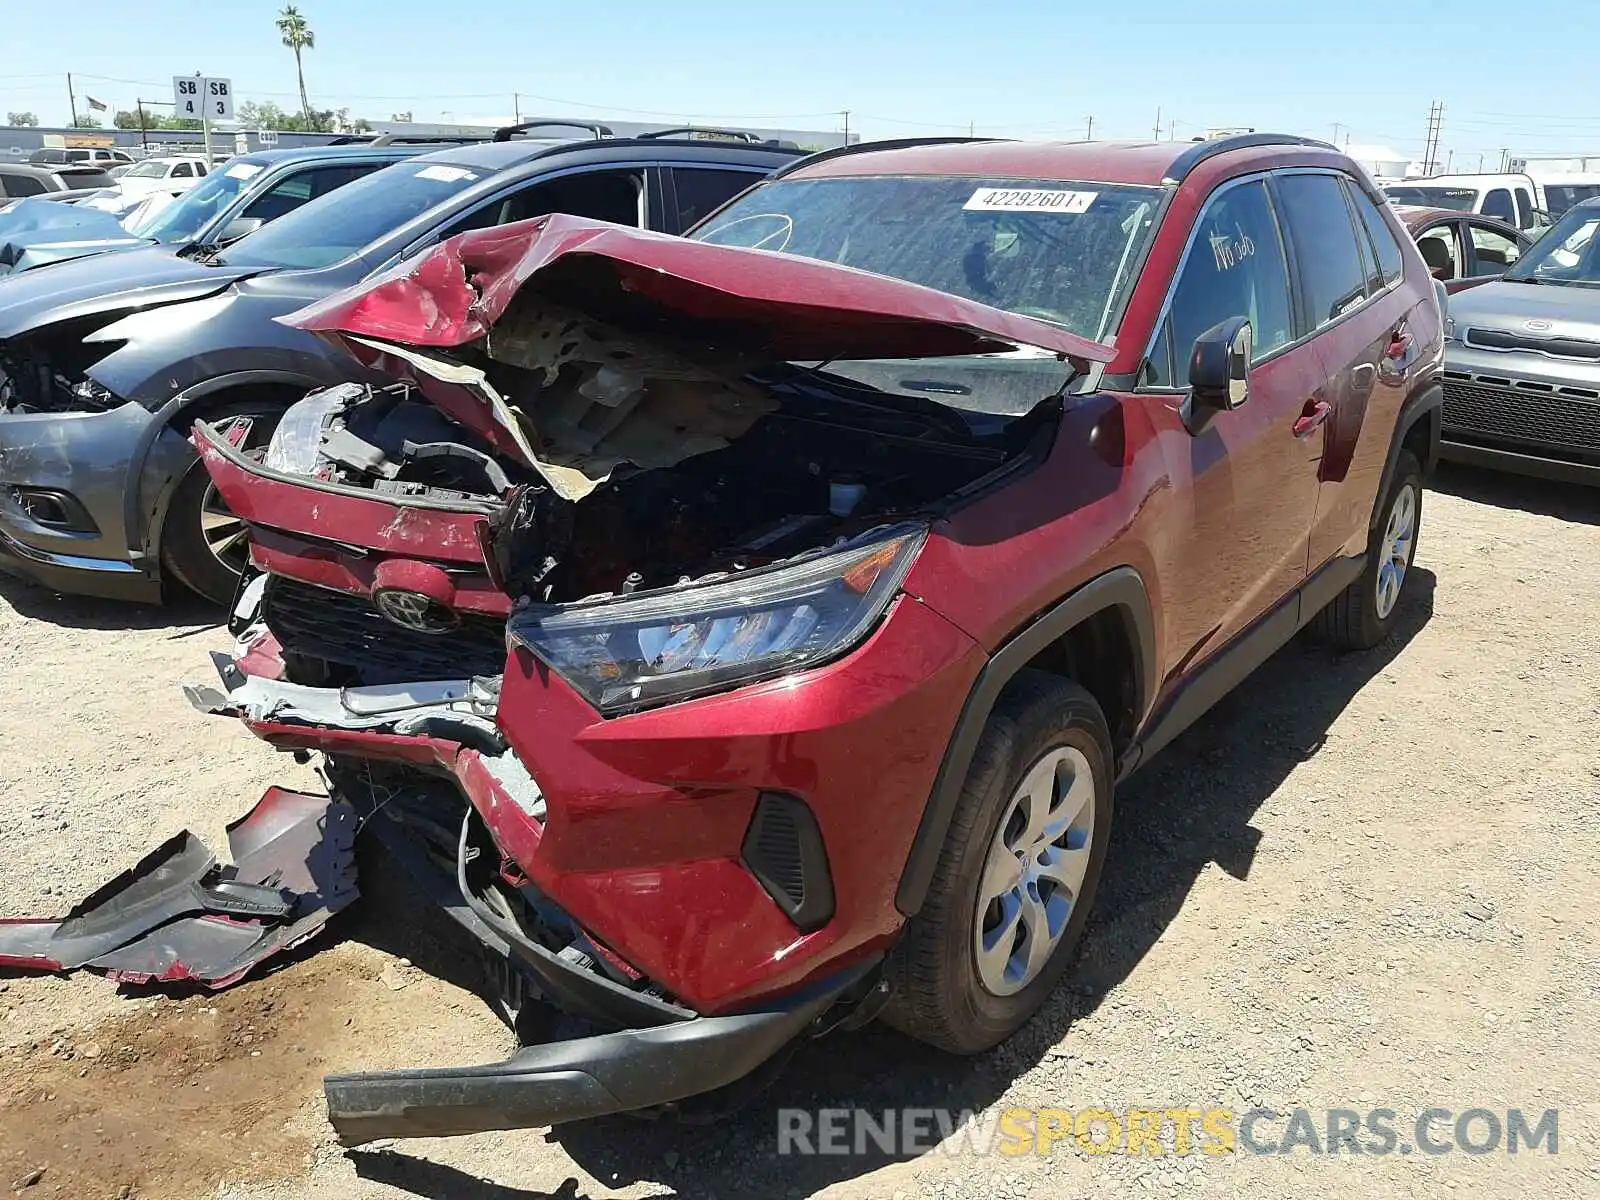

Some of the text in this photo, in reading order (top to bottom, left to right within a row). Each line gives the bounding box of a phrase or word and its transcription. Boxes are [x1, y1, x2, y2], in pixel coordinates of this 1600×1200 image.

[179, 80, 197, 94] SB
[210, 82, 228, 96] SB
[186, 100, 194, 113] 4
[216, 101, 225, 114] 3
